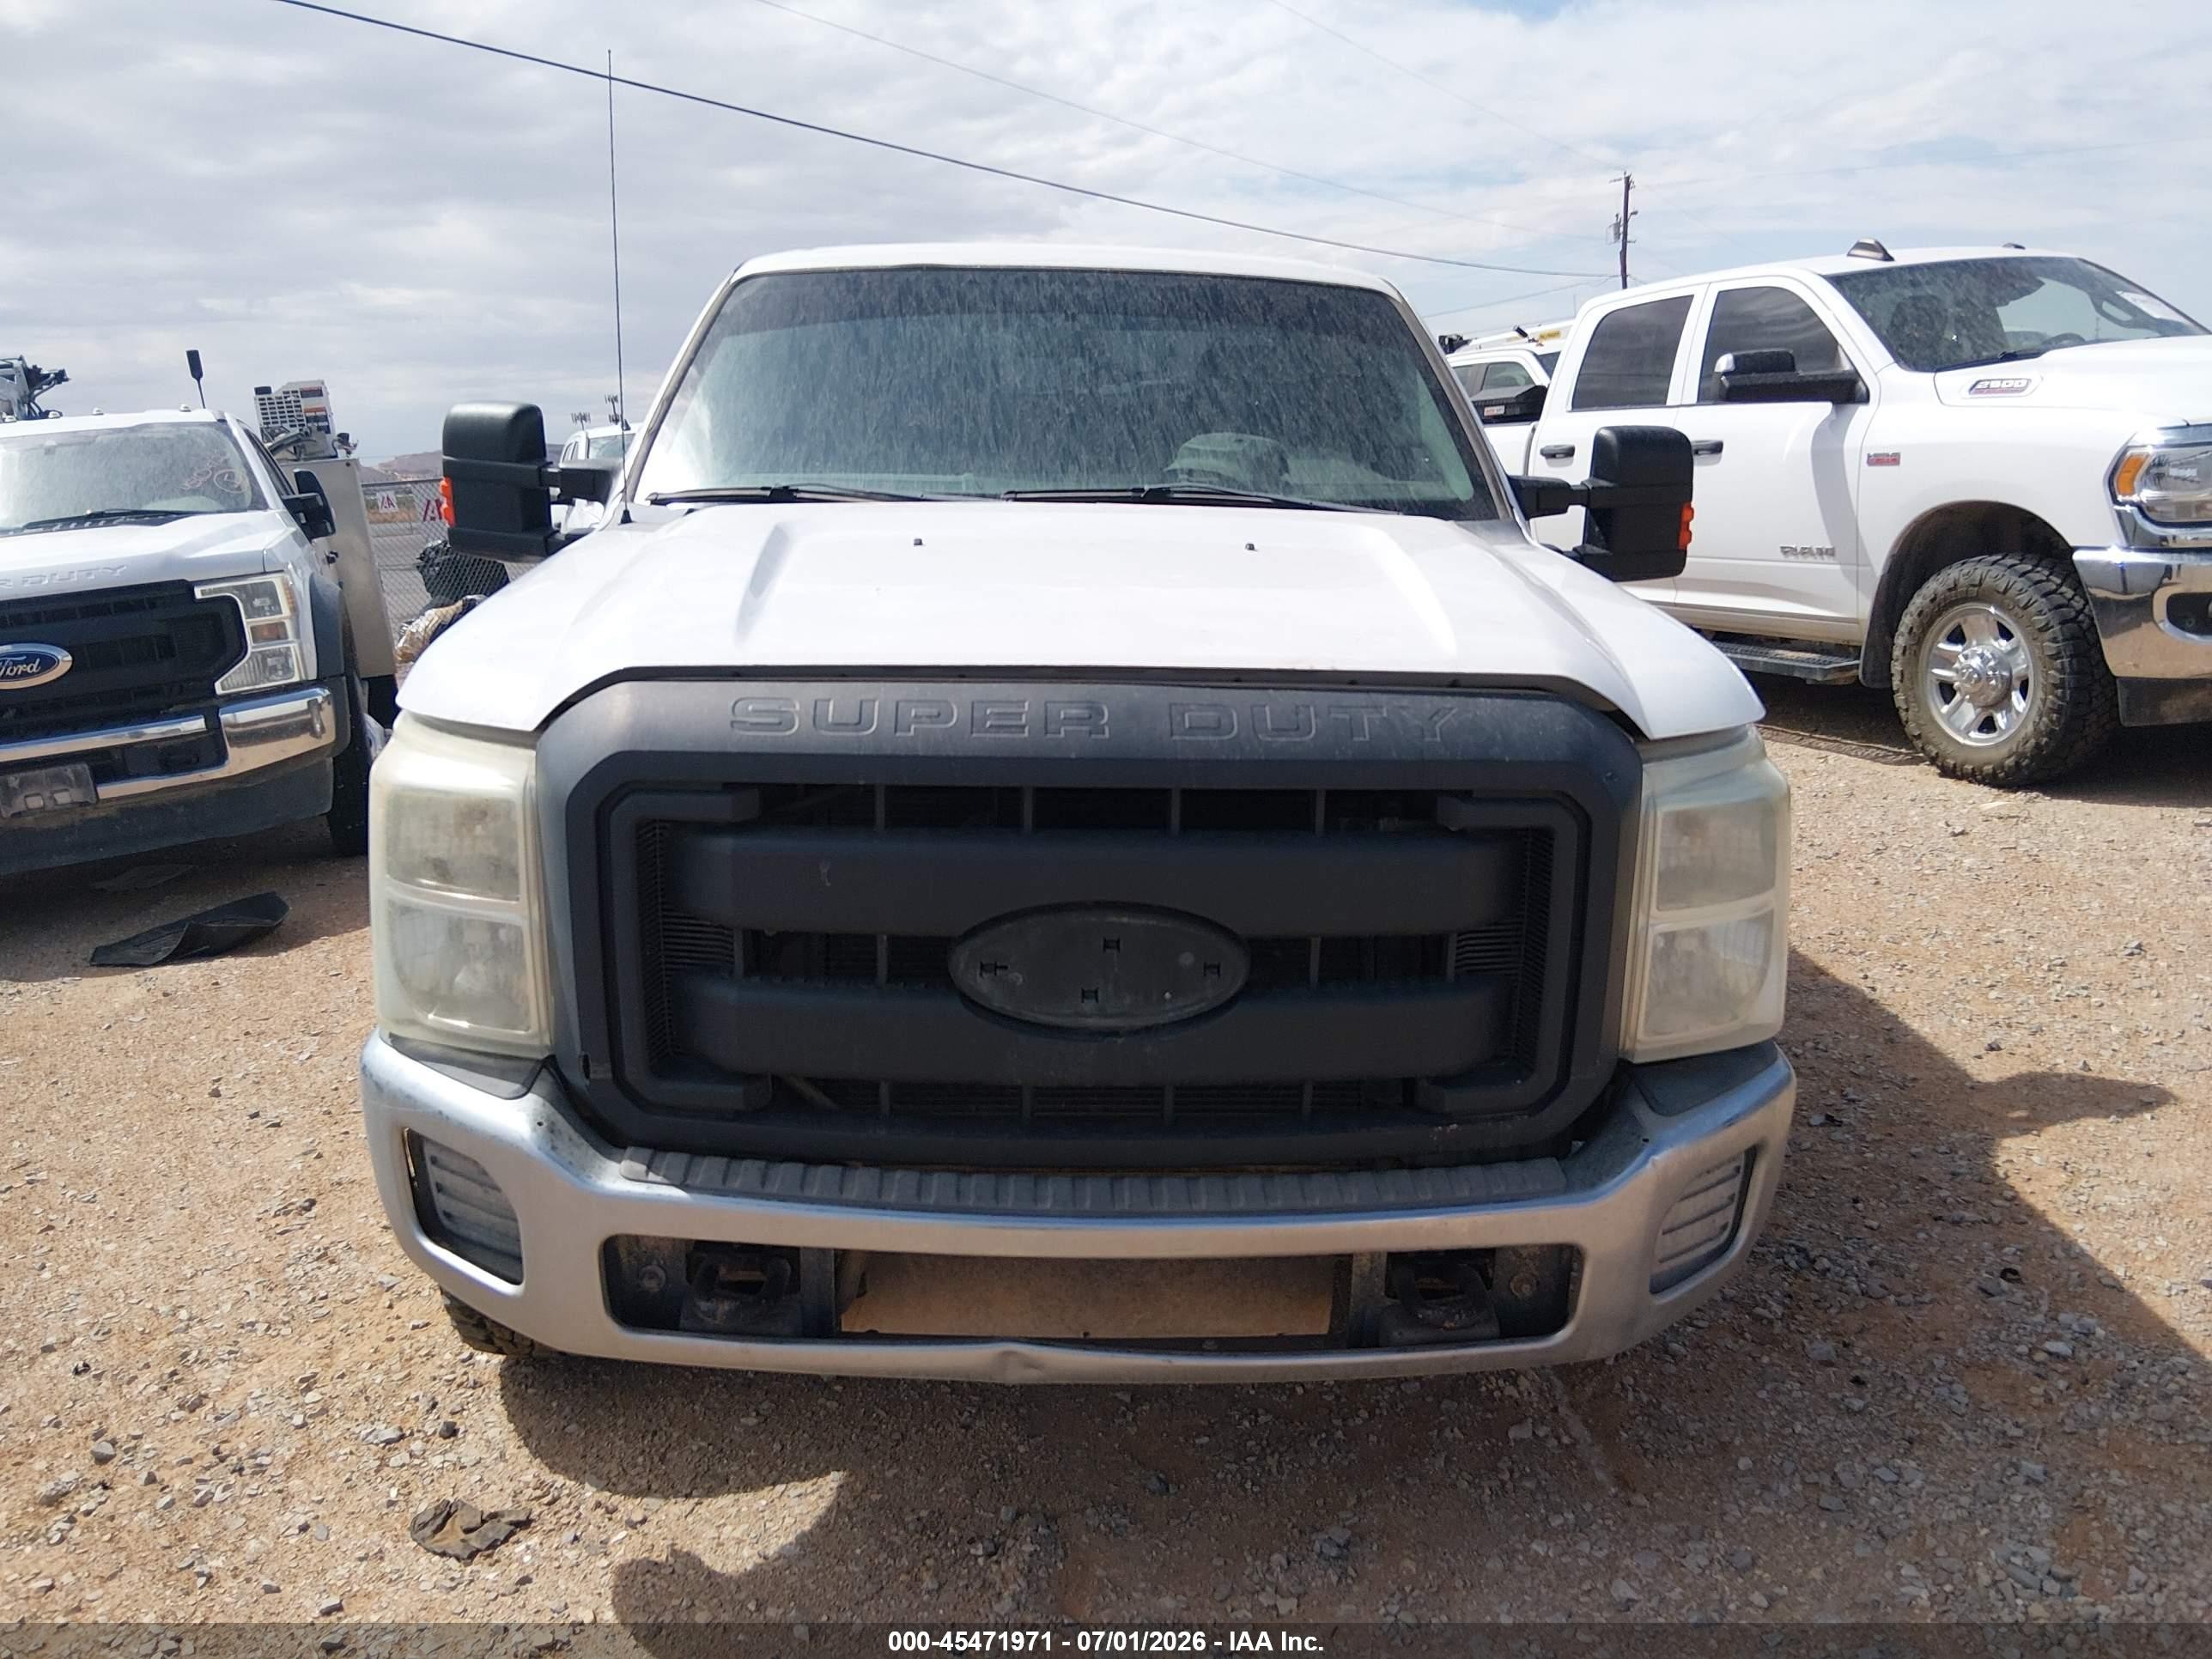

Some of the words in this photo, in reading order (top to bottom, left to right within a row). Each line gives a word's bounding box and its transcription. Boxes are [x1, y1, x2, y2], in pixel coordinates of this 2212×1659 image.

[21, 564, 127, 586] DUTY
[729, 696, 1109, 739] SUPER
[1170, 702, 1459, 742] DUTY
